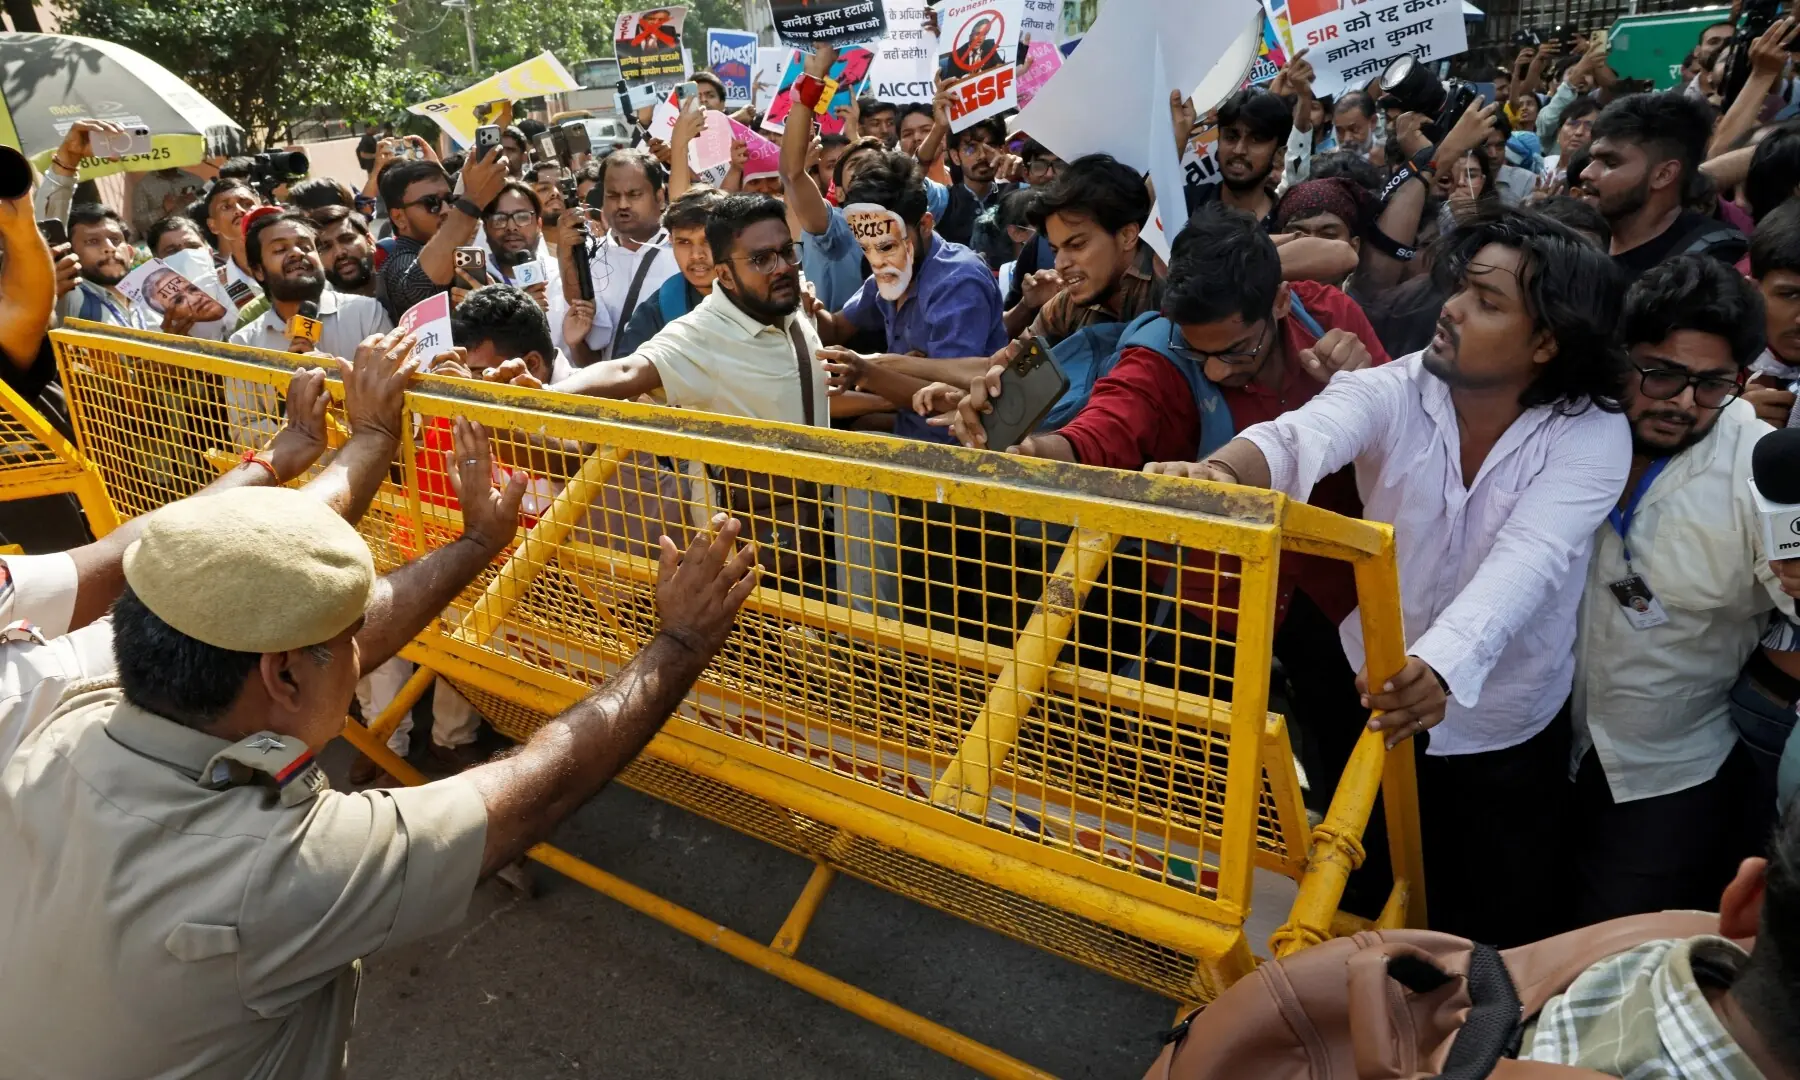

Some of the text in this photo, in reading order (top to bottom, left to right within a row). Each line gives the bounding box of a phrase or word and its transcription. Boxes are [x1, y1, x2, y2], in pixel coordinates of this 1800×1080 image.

[782, 0, 873, 29] ज्ञानेश कुमार हटाओ
[1306, 24, 1339, 46] SIR
[1344, 11, 1371, 33] को
[1375, 5, 1400, 23] रद्द
[812, 25, 844, 38] आयोग
[846, 17, 880, 31] बचाओ
[711, 40, 756, 65] GYANESH
[1326, 18, 1434, 64] ज्ञानेश कुमार
[1250, 59, 1278, 80] aisa
[1340, 53, 1399, 82] इस्तीफ
[726, 84, 748, 98] isa
[949, 68, 1014, 122] AISF
[847, 219, 897, 240] FASCIST
[1779, 541, 1800, 550] mo
